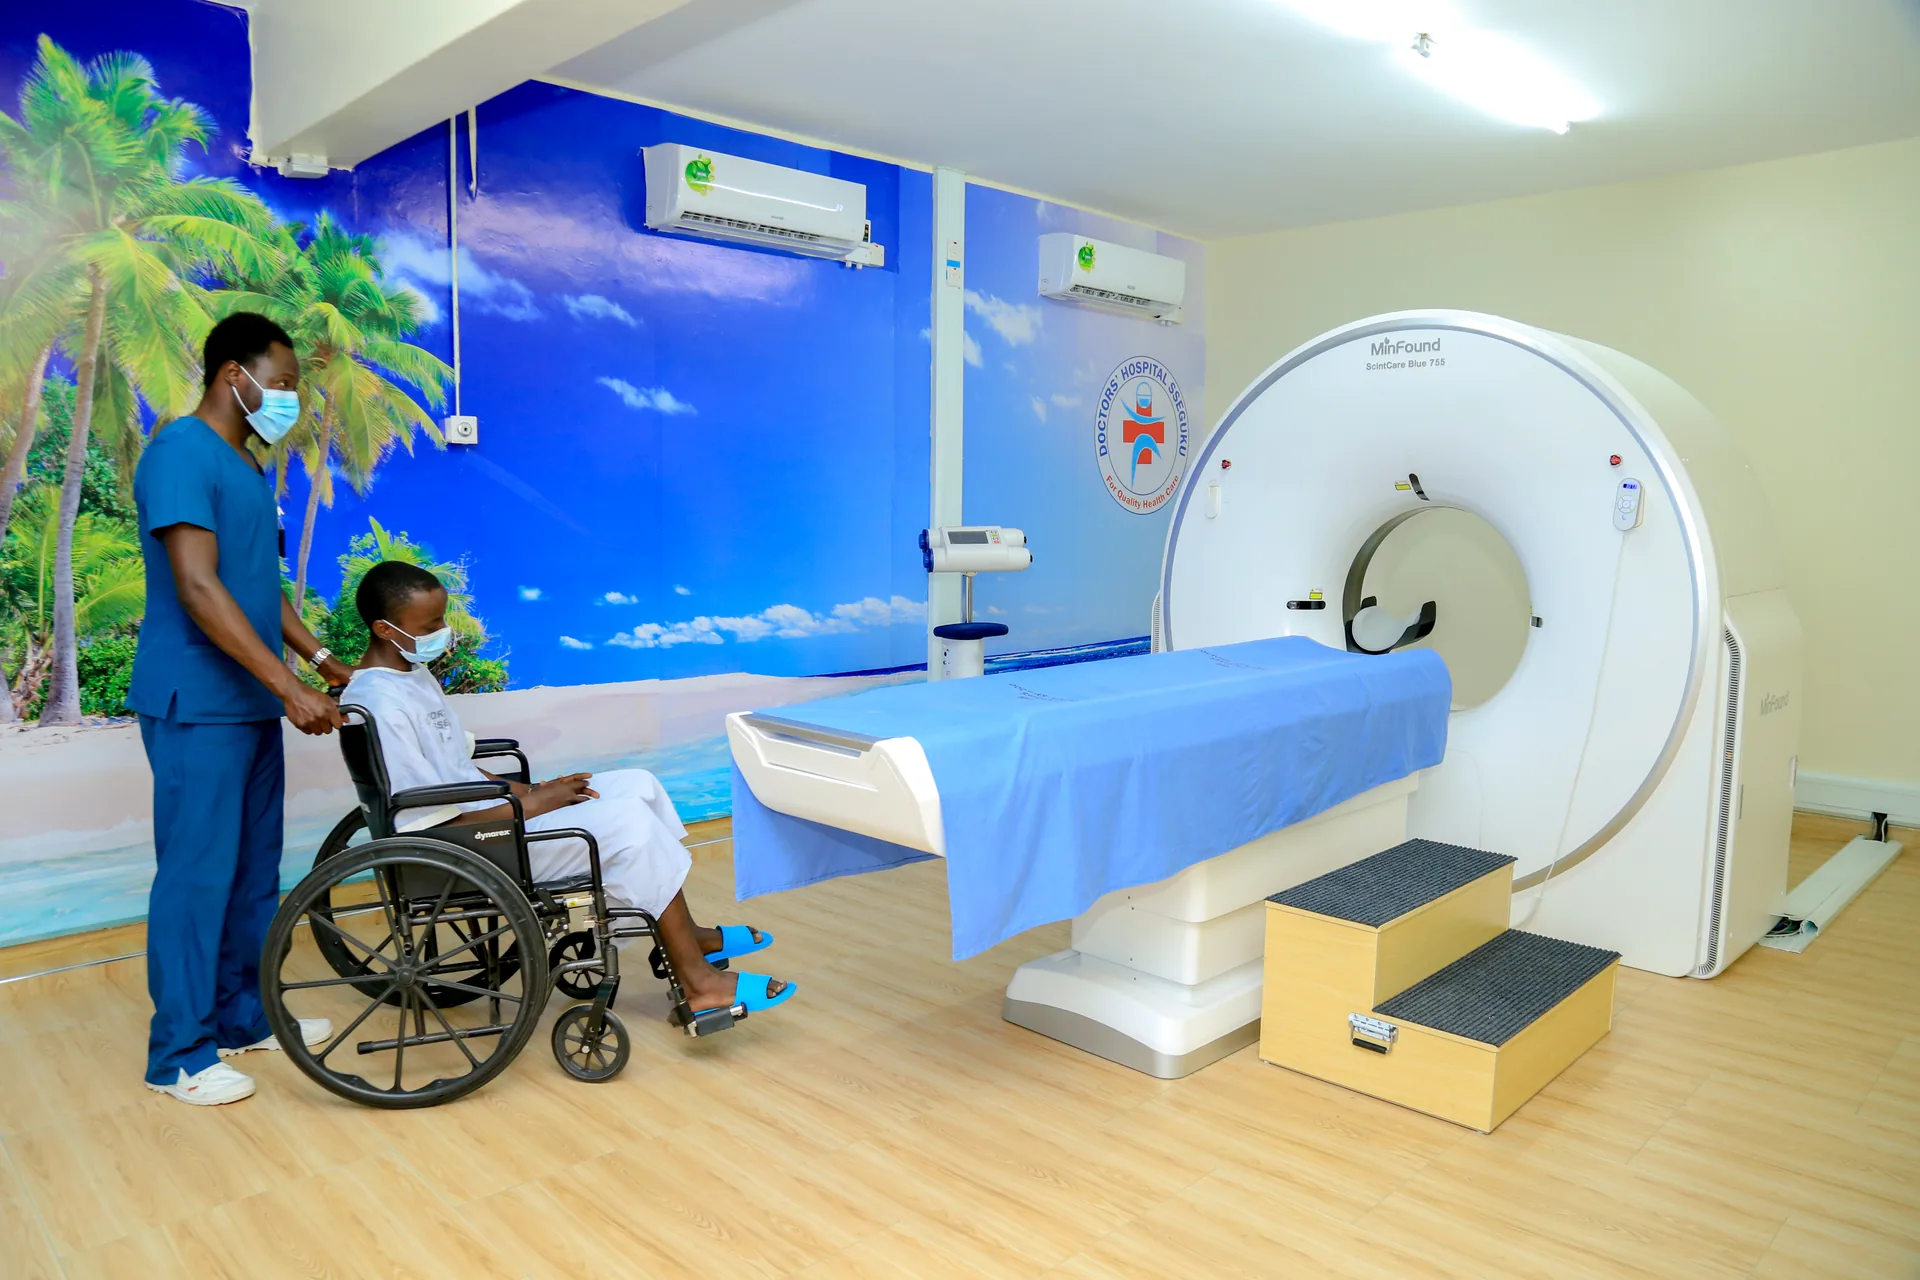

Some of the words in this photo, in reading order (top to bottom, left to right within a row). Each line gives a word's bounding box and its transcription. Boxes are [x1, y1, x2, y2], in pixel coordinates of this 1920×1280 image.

[1371, 337, 1441, 356] MinFound
[1366, 361, 1406, 371] ScintCare
[1408, 360, 1427, 368] Blue
[1429, 358, 1446, 367] 755
[1121, 361, 1168, 386] HOSPITAL
[1168, 382, 1188, 457] SSEGUKU
[1106, 475, 1118, 492] For
[1117, 489, 1141, 510] Quality
[1142, 494, 1166, 509] Health
[1165, 475, 1179, 496] Care
[474, 829, 511, 841] dynarex
